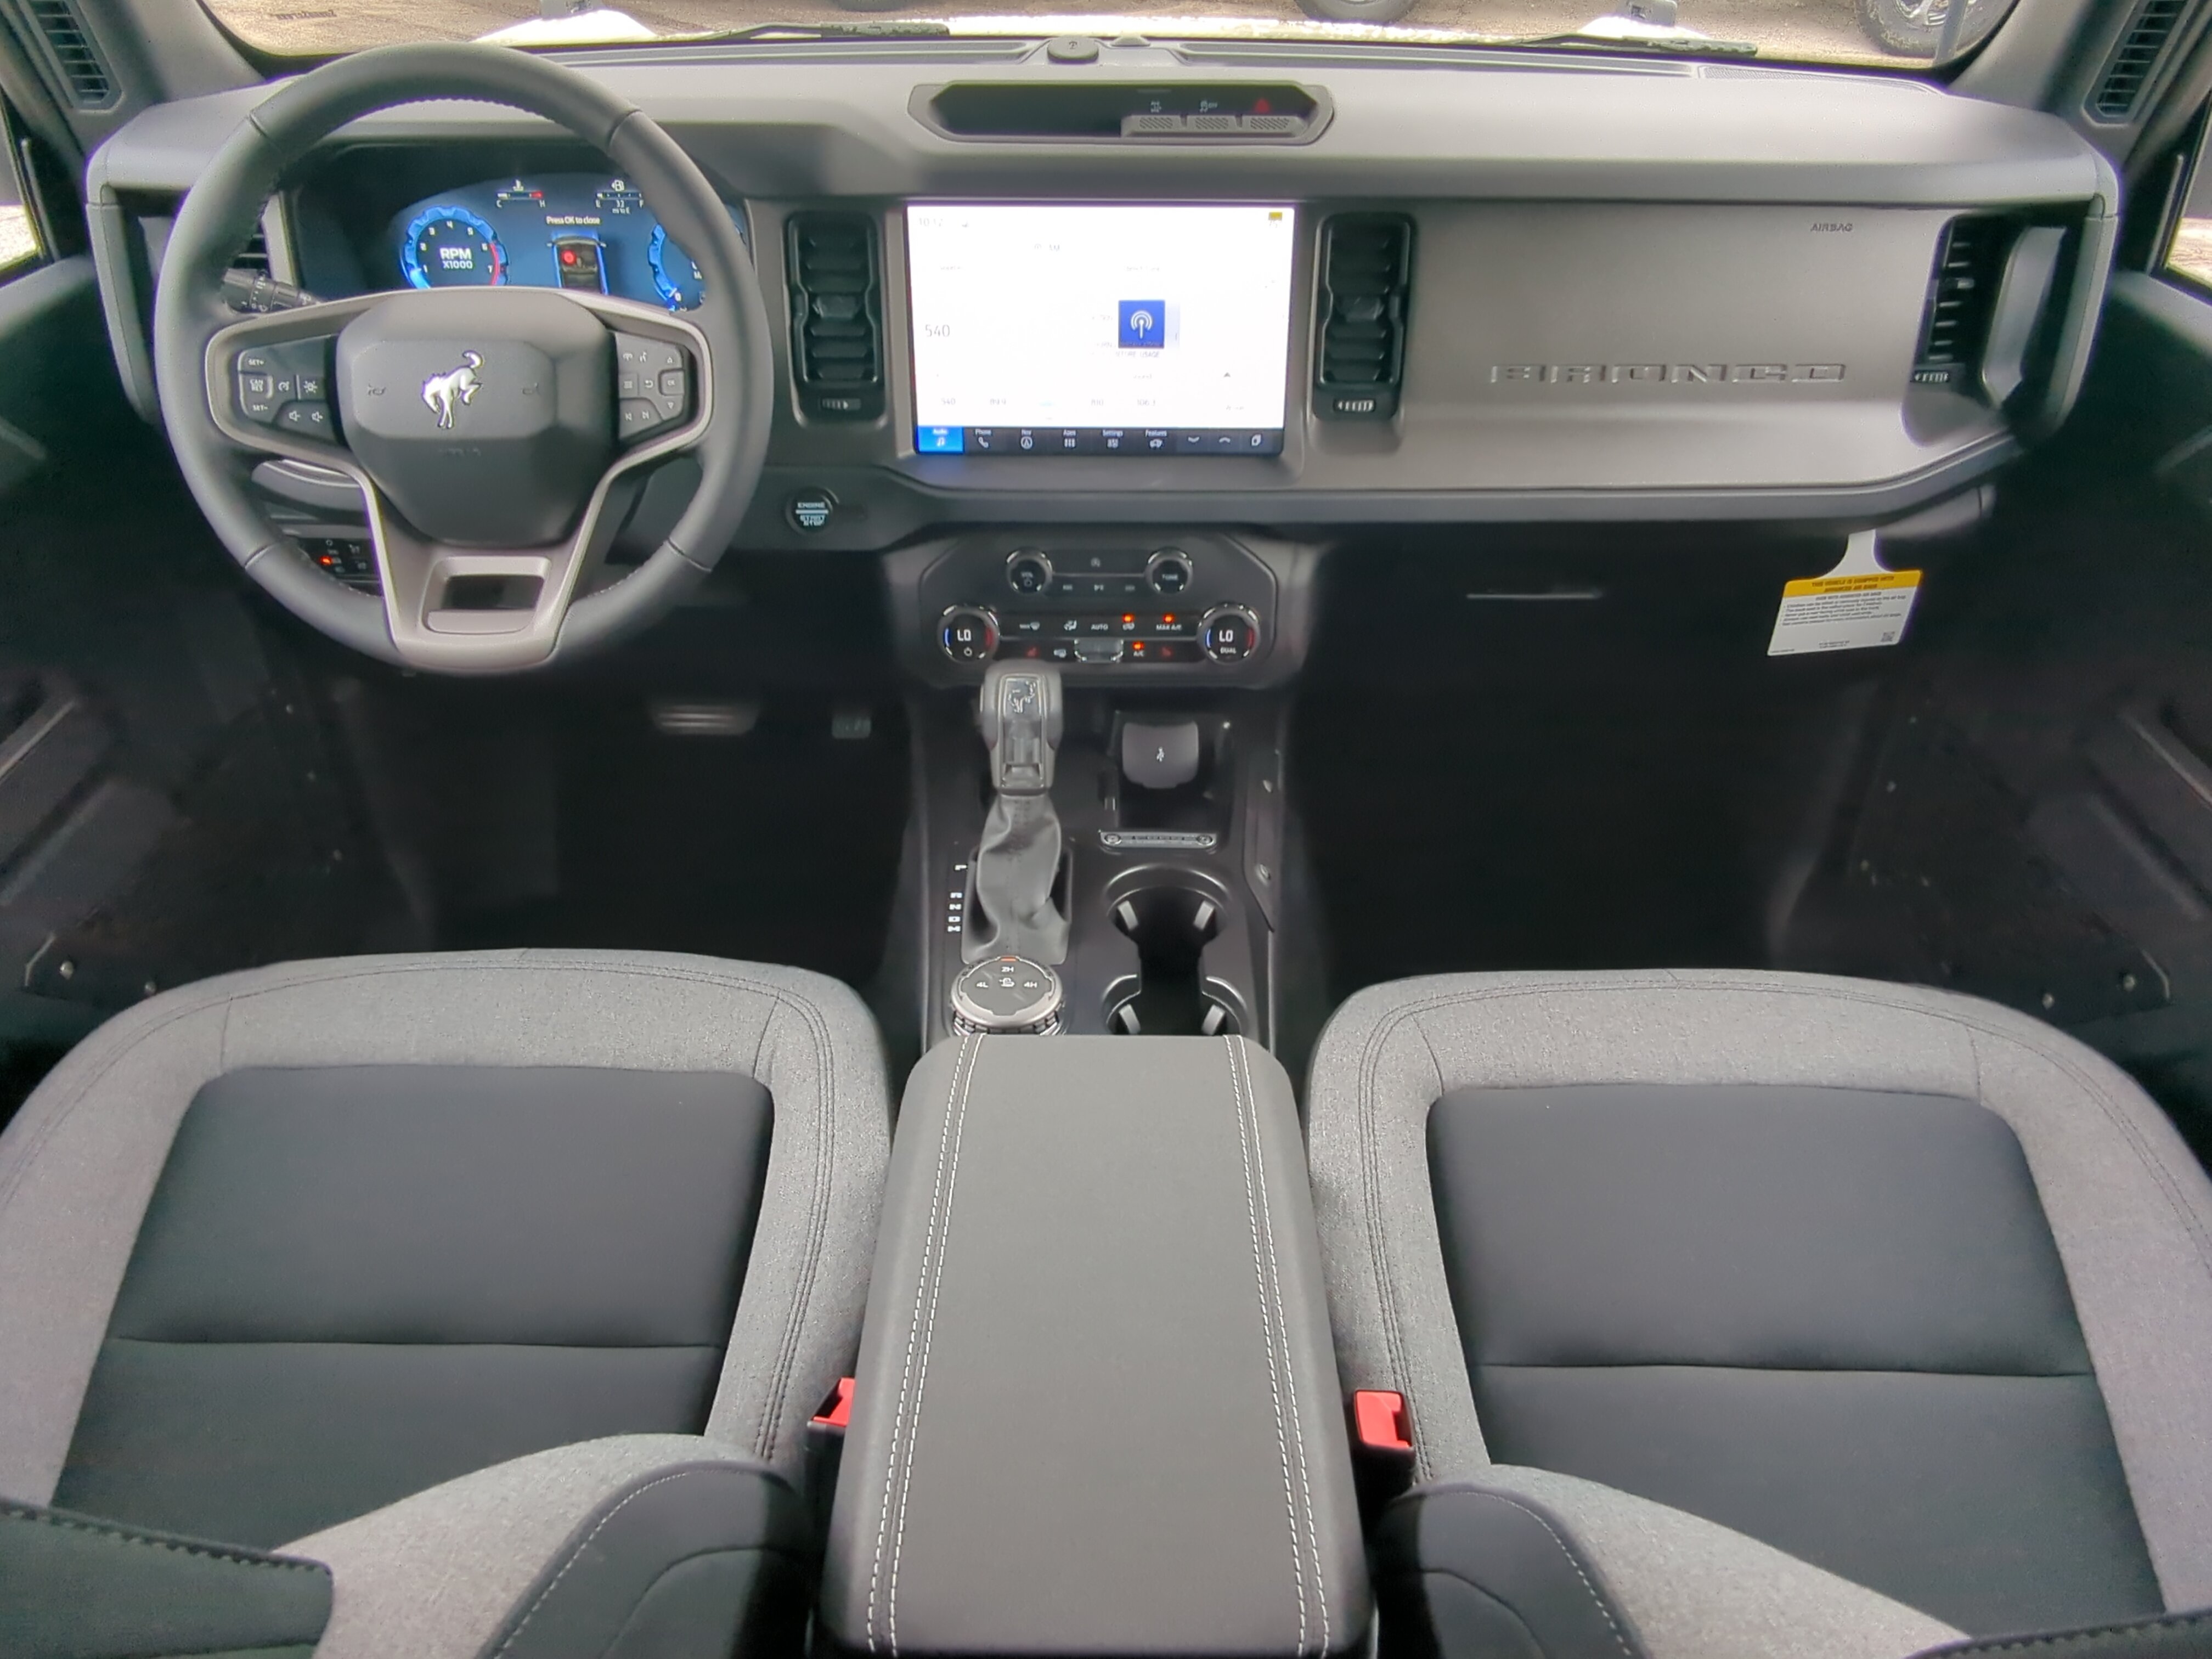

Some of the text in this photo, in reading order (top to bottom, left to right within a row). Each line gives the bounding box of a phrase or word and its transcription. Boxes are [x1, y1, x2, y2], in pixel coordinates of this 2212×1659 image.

[546, 216, 563, 224] Press
[564, 216, 574, 224] OK
[583, 216, 601, 224] close
[428, 227, 435, 235] 3
[467, 227, 473, 235] 5
[1810, 223, 1853, 232] AIRBAG
[439, 248, 472, 260] RPM
[423, 264, 428, 273] 1
[442, 260, 473, 269] X1000
[925, 324, 950, 337] 540
[1490, 364, 1847, 383] BRONCO
[957, 629, 971, 641] LO
[1219, 629, 1233, 642] LO
